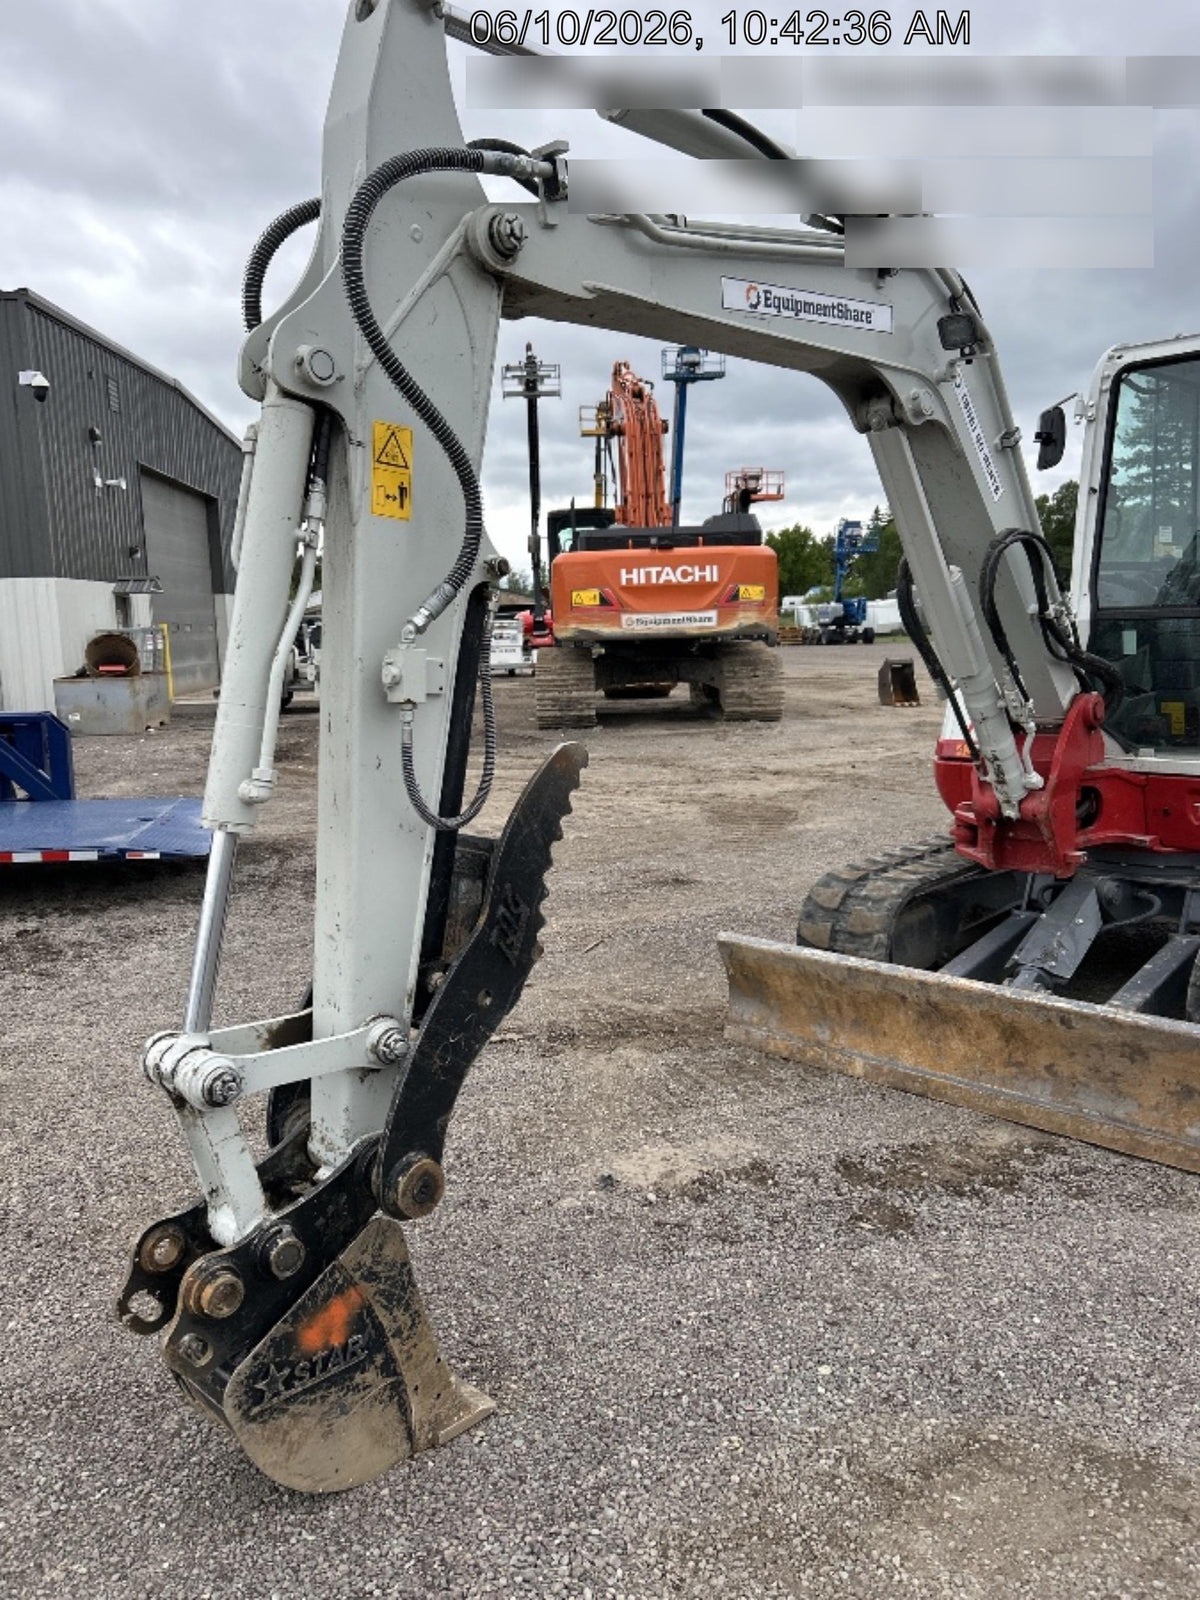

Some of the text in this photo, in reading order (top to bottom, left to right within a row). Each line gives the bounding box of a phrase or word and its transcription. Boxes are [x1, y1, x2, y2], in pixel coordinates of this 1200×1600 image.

[763, 289, 873, 324] EquipmentShare
[620, 565, 719, 586] HITACHI
[294, 1334, 369, 1388] STAR
